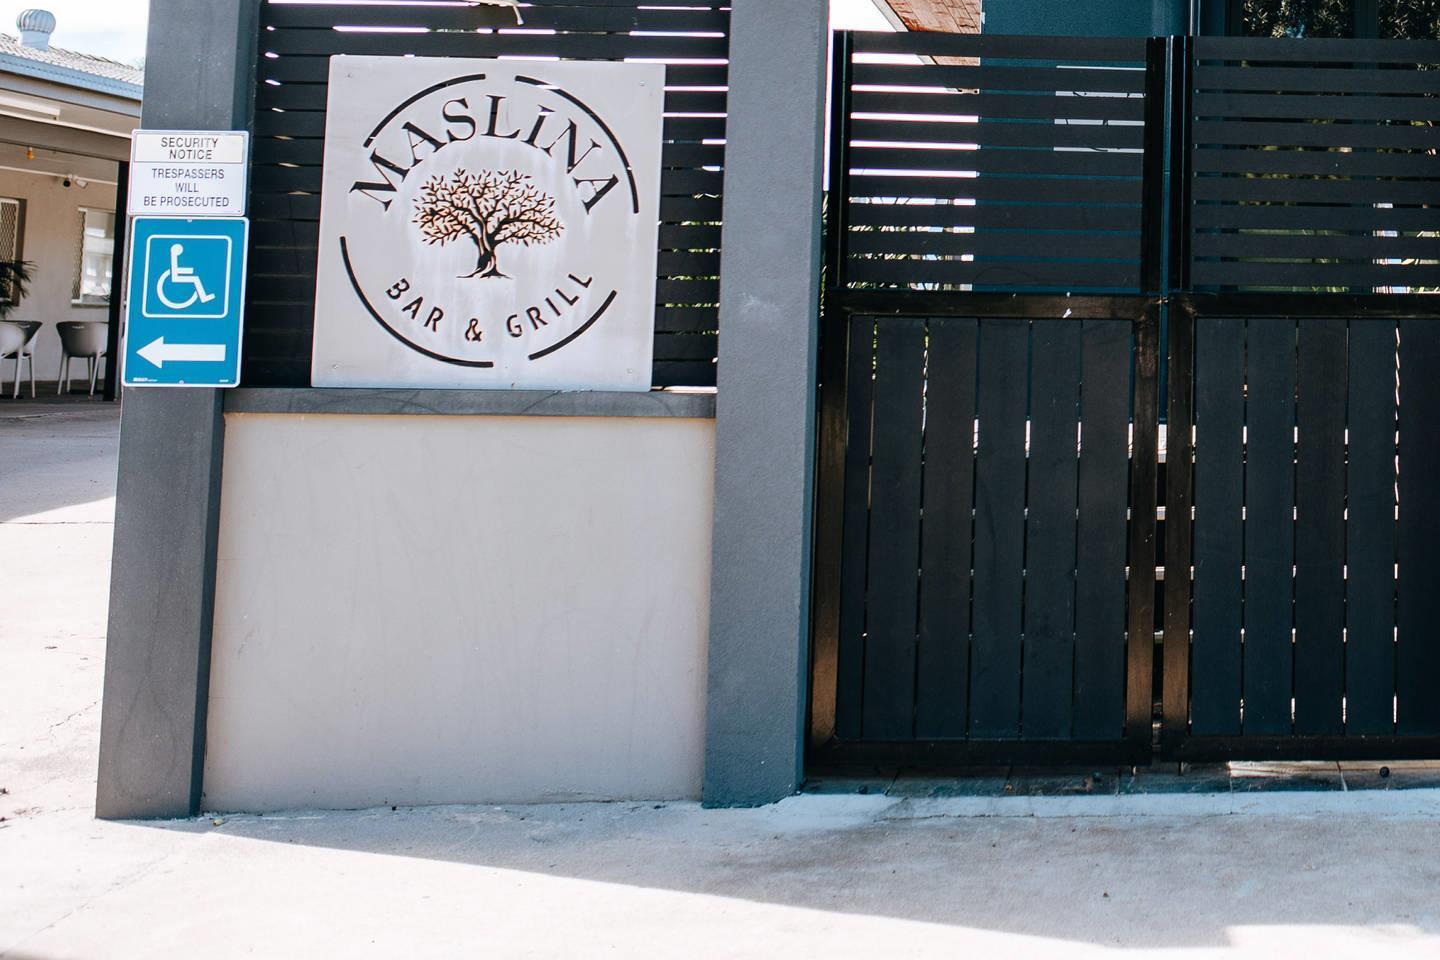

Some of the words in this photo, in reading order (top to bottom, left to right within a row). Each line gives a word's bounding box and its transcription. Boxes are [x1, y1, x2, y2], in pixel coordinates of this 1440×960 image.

[160, 136, 218, 148] SECURITY
[169, 149, 212, 159] NOTICE
[349, 94, 619, 215] MASLINA
[151, 168, 224, 179] TRESPASSERS
[175, 182, 200, 193] WILL
[143, 195, 157, 206] BE
[160, 195, 229, 207] PROSECUTED
[386, 278, 444, 333] BAR
[465, 318, 482, 342] &
[506, 273, 593, 338] GRILL
